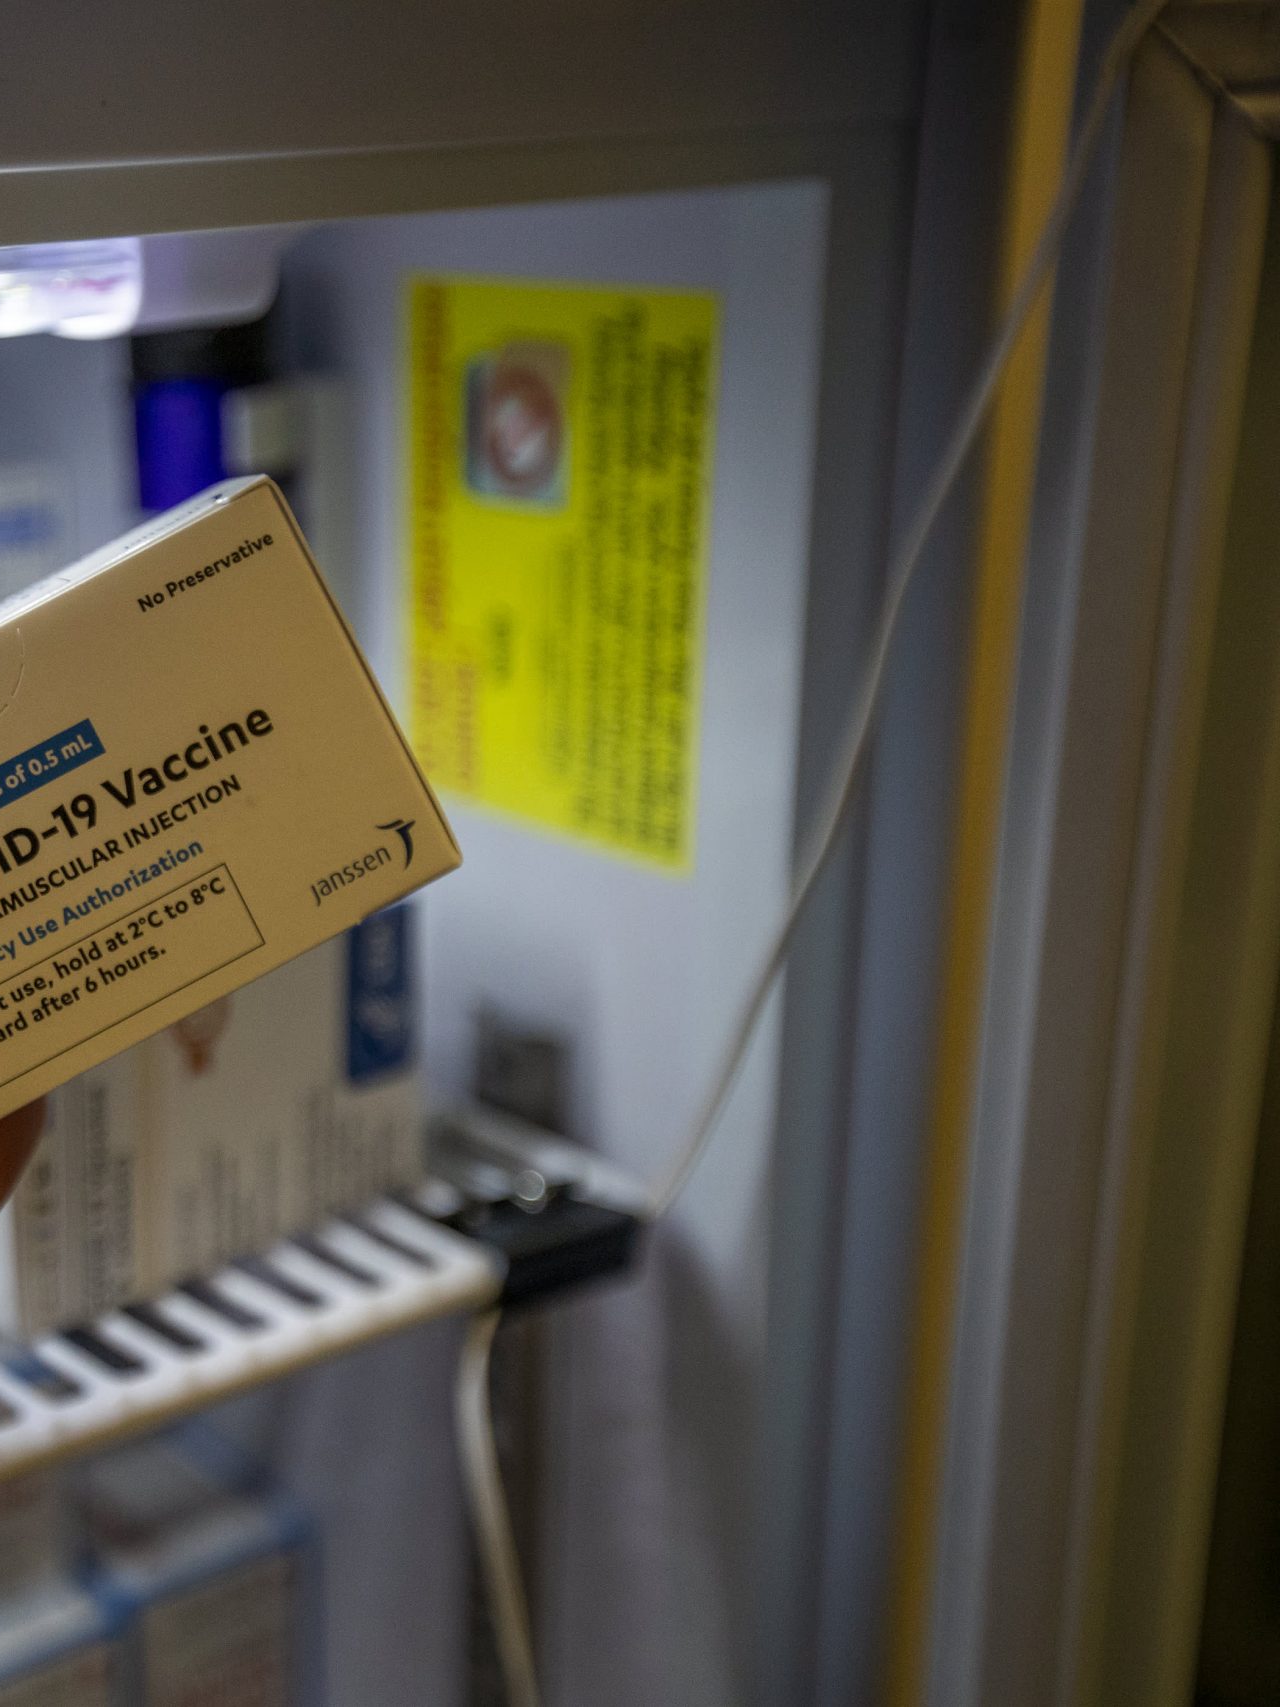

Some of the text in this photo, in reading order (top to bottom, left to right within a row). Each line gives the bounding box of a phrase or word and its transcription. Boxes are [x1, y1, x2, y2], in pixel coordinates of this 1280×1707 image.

[137, 592, 165, 613] No
[166, 533, 274, 598] Preservative
[5, 764, 27, 789] of
[30, 754, 58, 776] 0.5
[62, 733, 93, 760] mL
[100, 708, 274, 809] Vaccine
[123, 775, 241, 849] INJECTION
[18, 915, 58, 946] Use
[63, 841, 204, 925] Authorization
[10, 977, 54, 1005] use,
[53, 939, 101, 978] hold
[106, 931, 128, 947] at
[128, 910, 163, 940] 2°C
[164, 899, 188, 919] to
[190, 877, 226, 905] 8°C
[32, 985, 80, 1023] after
[85, 978, 98, 993] 6
[98, 948, 166, 985] hours.
